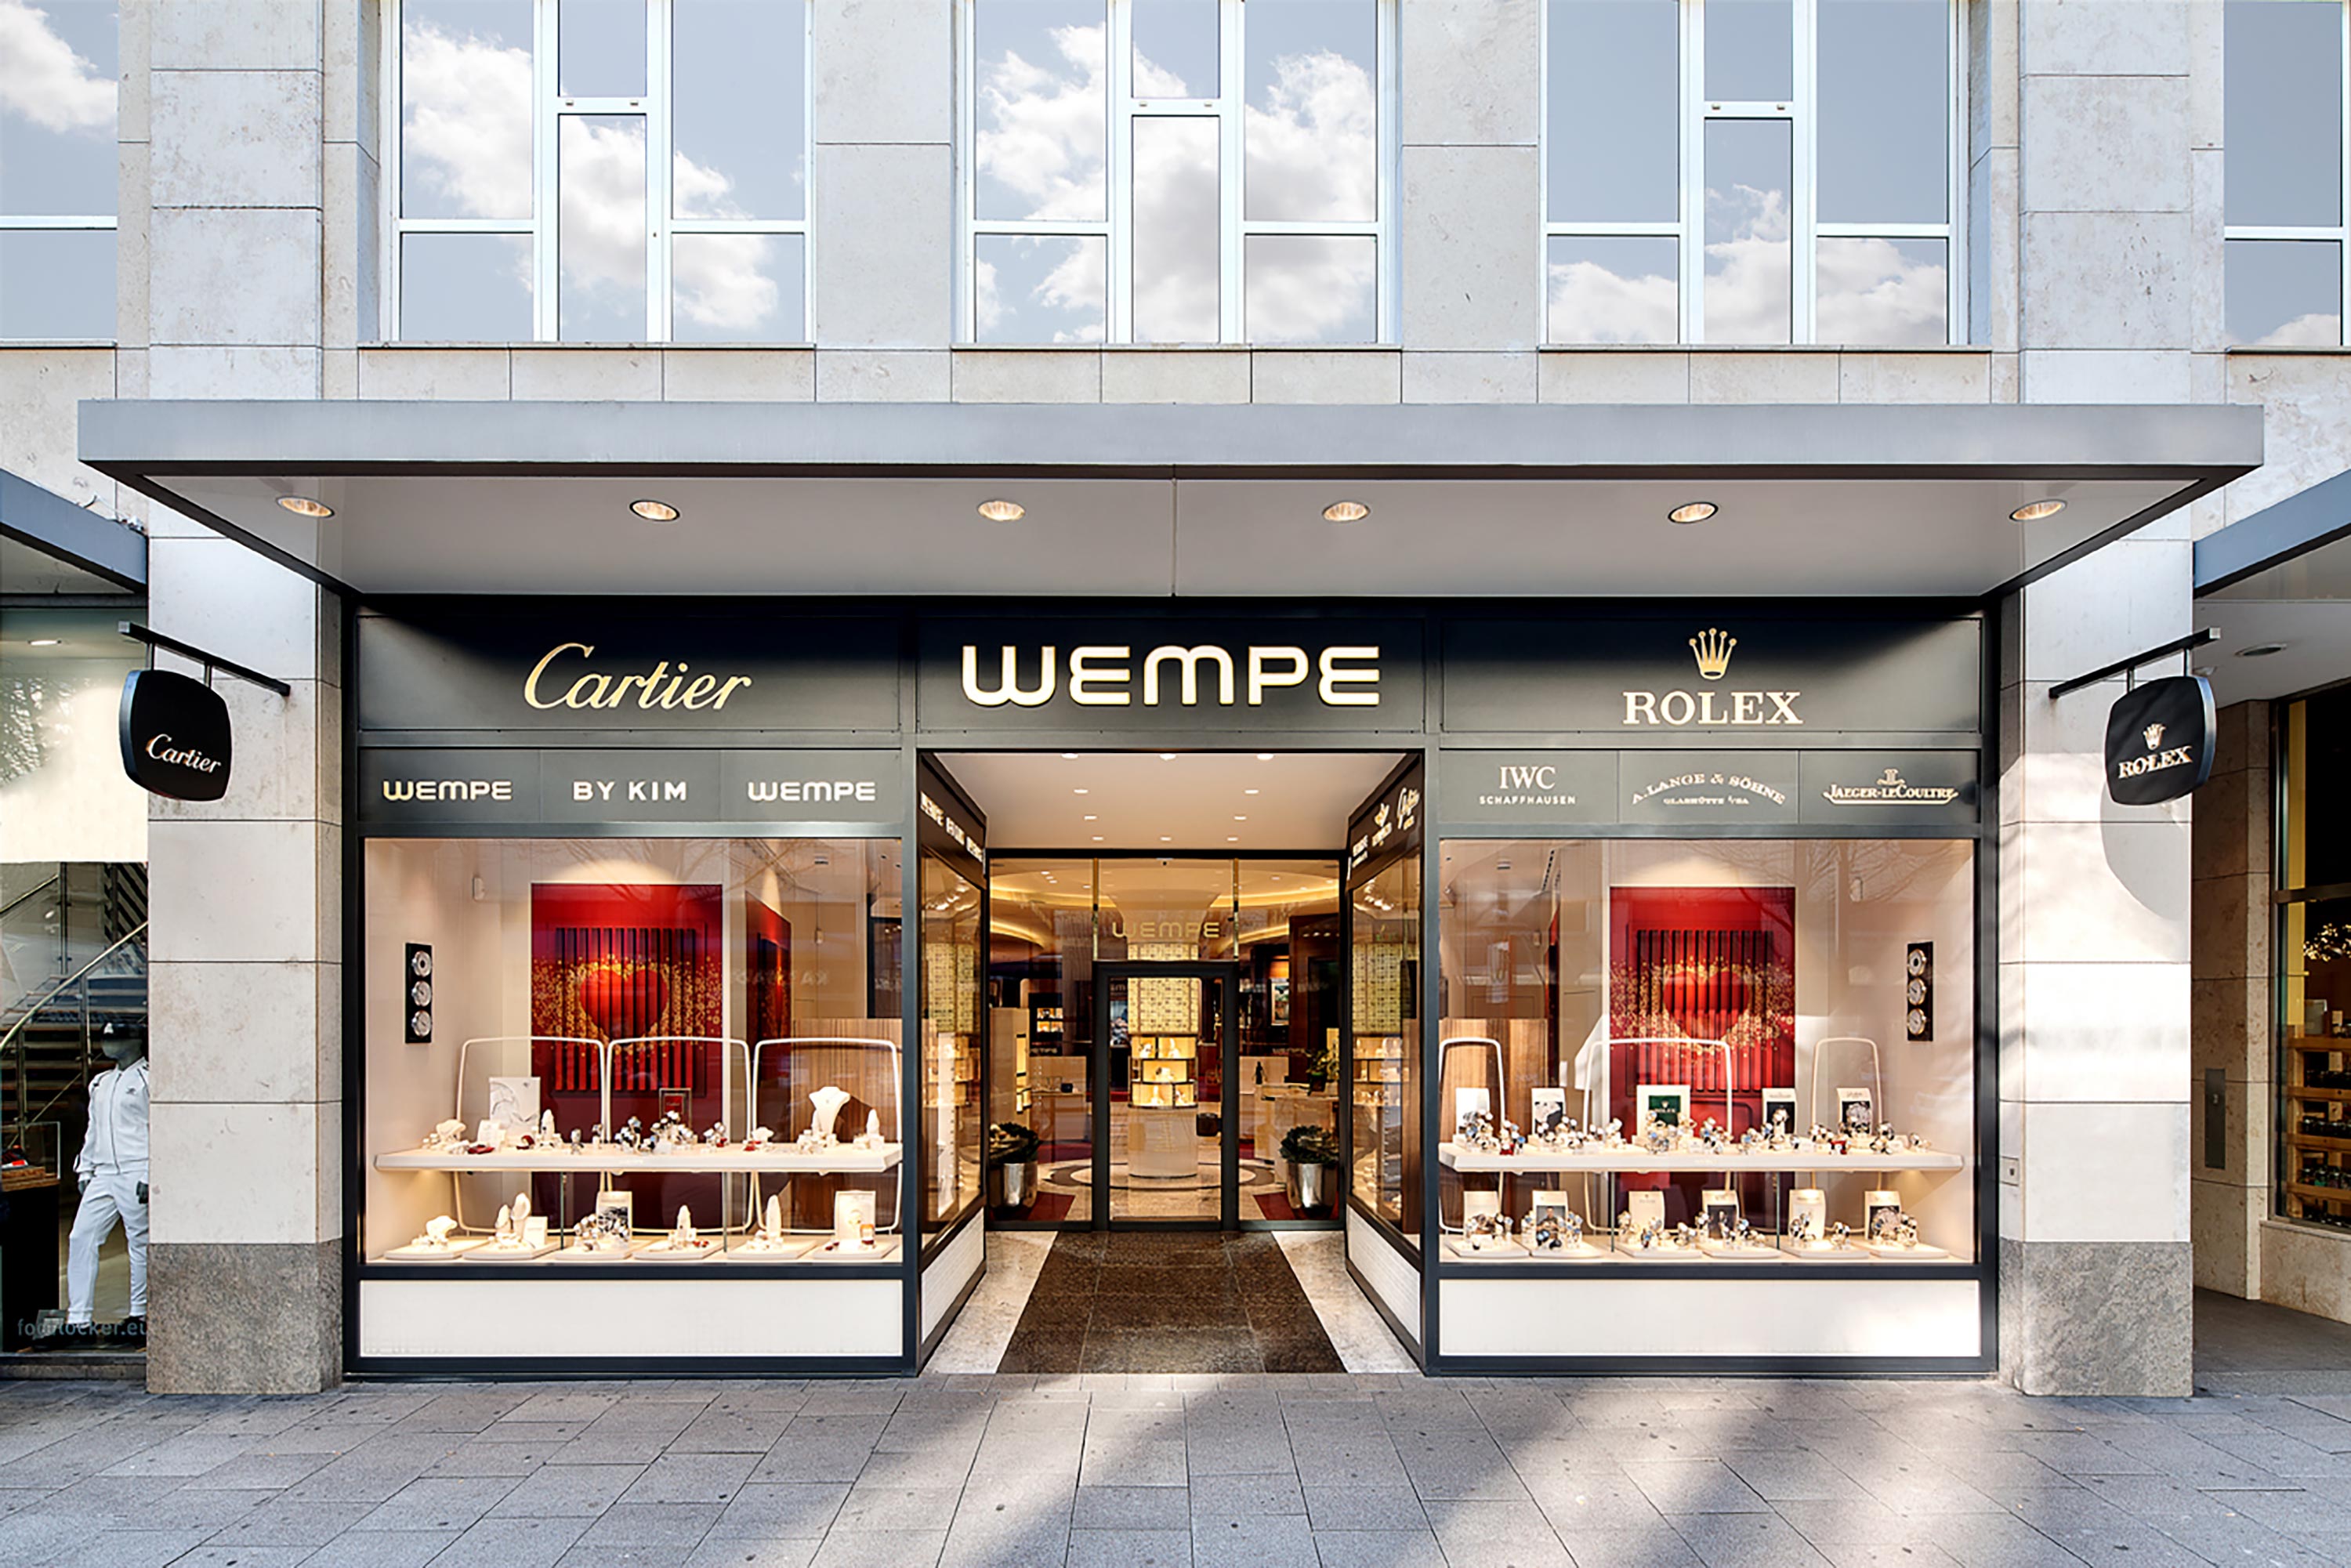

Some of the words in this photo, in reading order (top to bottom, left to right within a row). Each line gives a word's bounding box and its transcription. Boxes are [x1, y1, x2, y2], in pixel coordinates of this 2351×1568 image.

[524, 643, 752, 710] Cartier
[962, 645, 1380, 706] WEMPE
[1622, 690, 1803, 726] ROLEX
[146, 733, 222, 773] Cartier
[2118, 746, 2193, 779] ROLEX
[382, 780, 513, 802] WEMPE
[572, 780, 616, 802] BY
[628, 780, 687, 802] KIM
[747, 780, 877, 802] WEMPE
[1498, 766, 1556, 790] IWC
[1709, 773, 1725, 785] &
[1728, 776, 1787, 806] SÖHNE
[1479, 795, 1577, 806] SCHAFFHAUSEN
[1112, 921, 1220, 939] WEMPE
